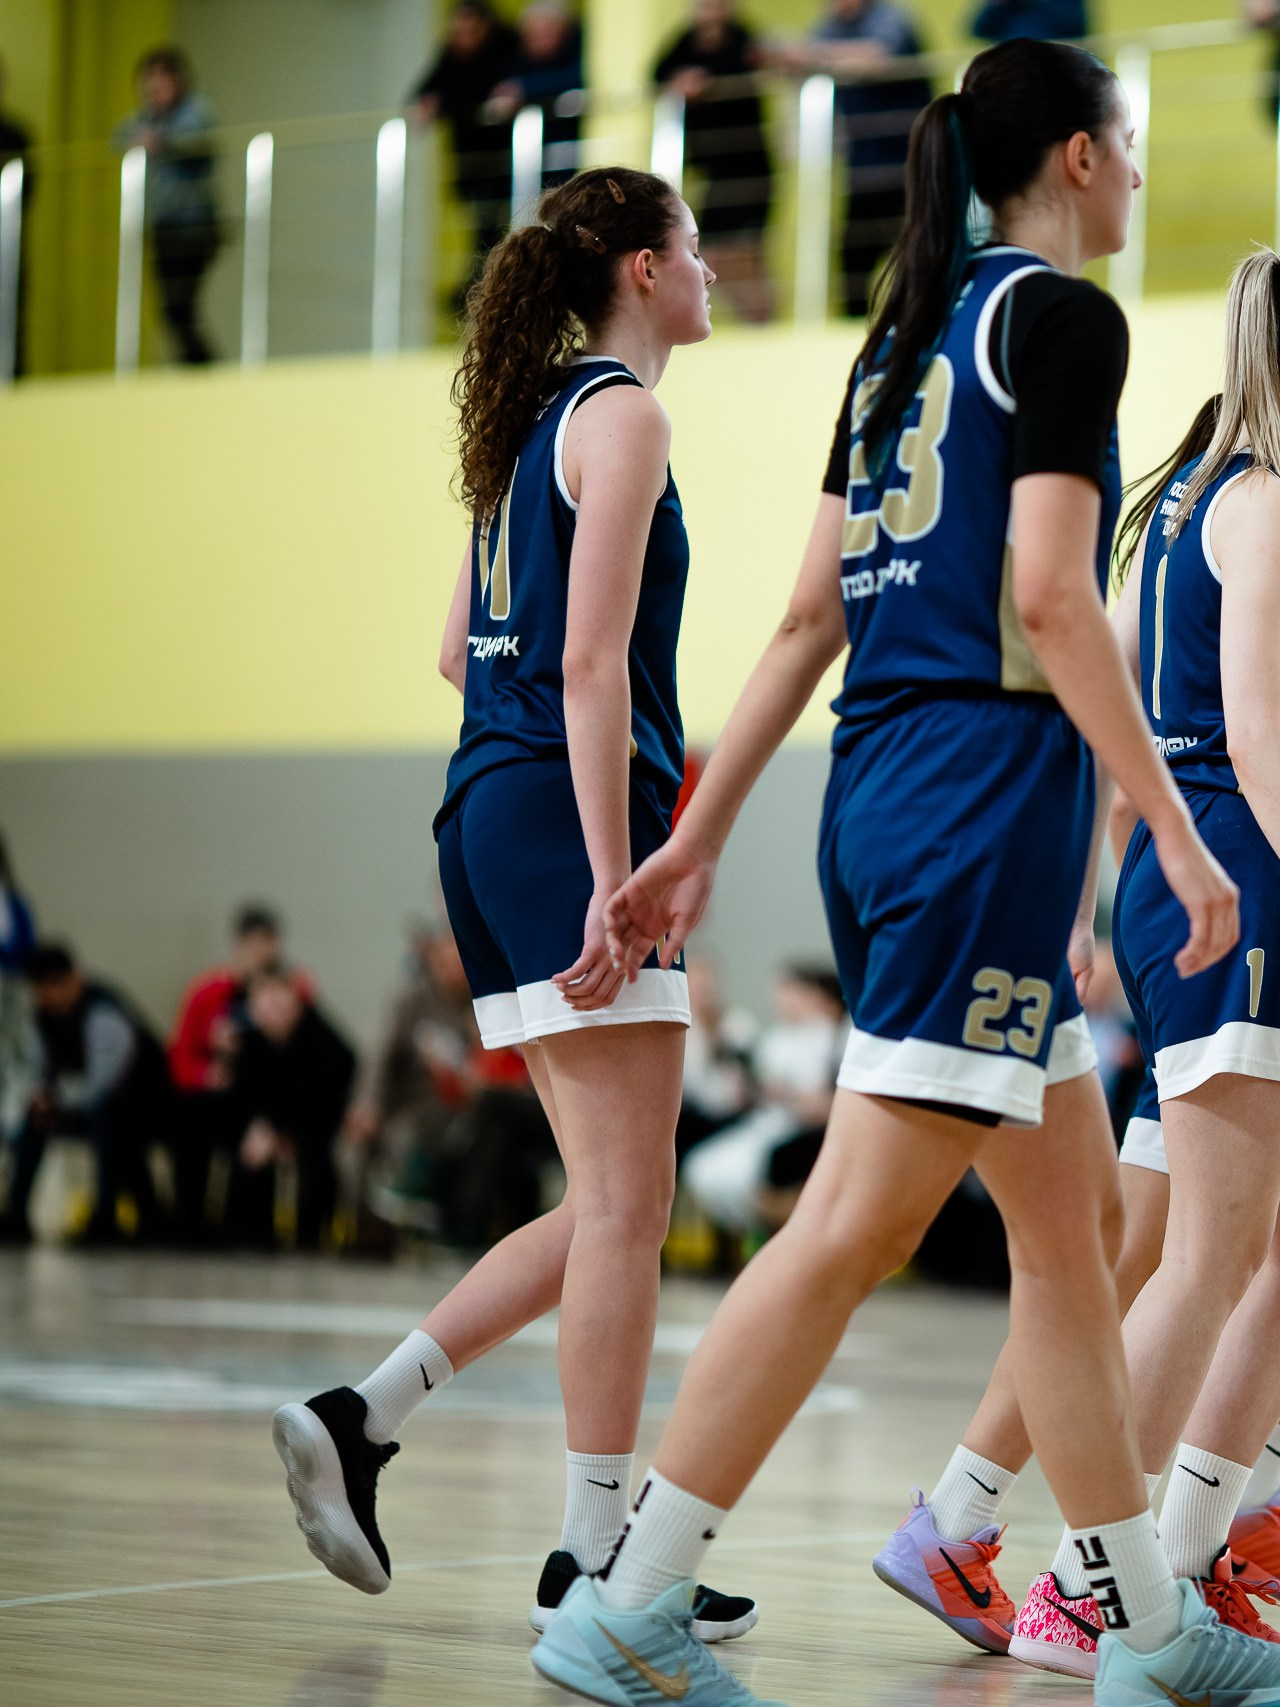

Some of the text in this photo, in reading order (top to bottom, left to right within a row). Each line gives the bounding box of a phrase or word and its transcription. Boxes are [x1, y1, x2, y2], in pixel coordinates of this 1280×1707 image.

[1153, 553, 1169, 720] 1
[962, 966, 1053, 1058] 23
[1246, 947, 1265, 1018] 1
